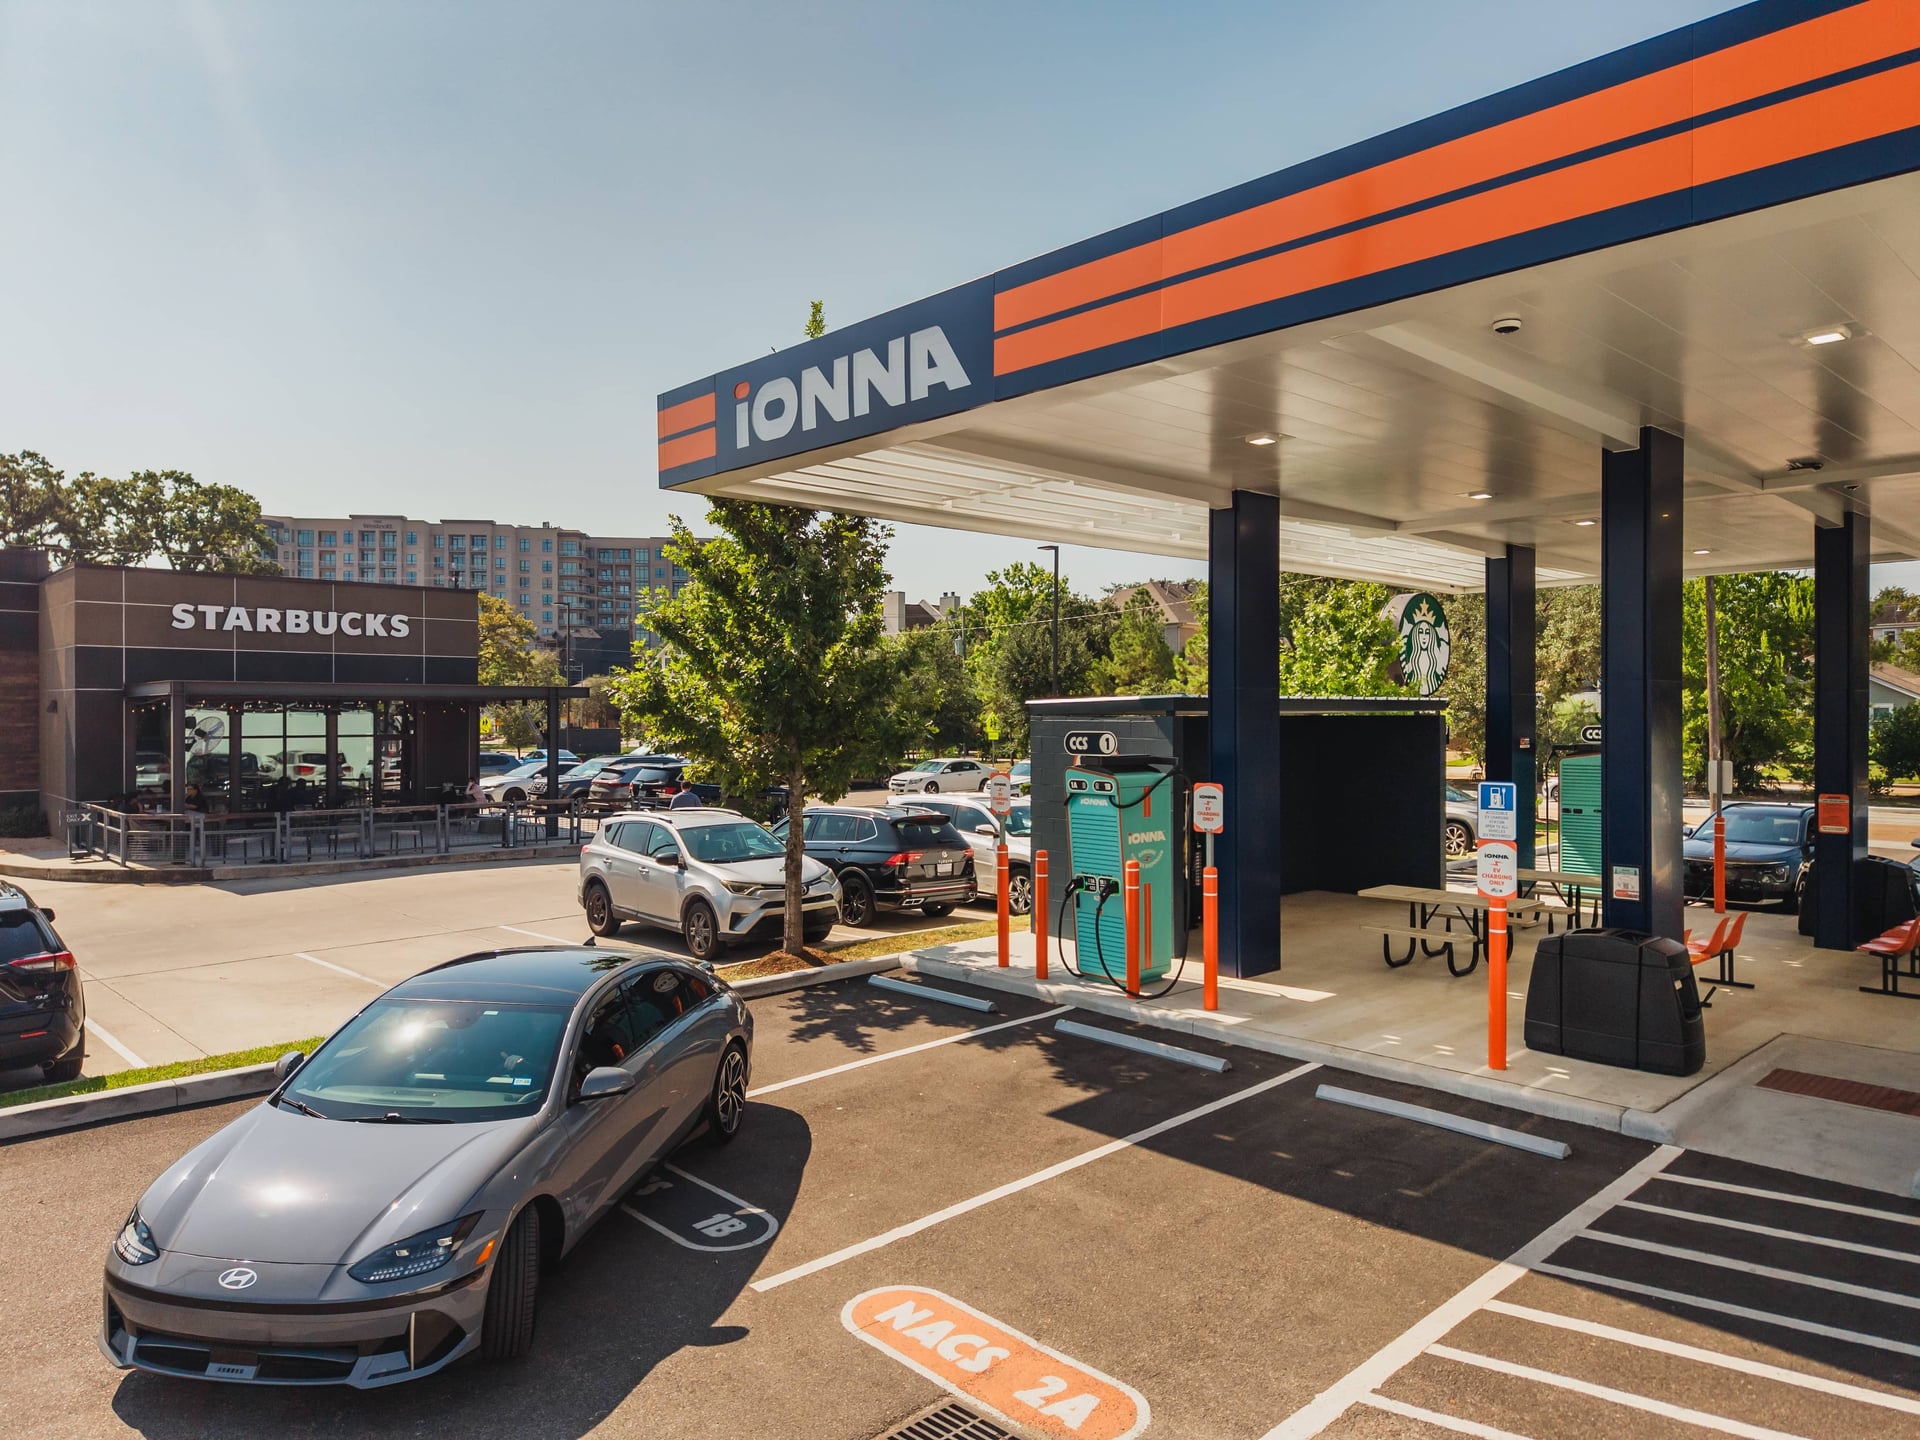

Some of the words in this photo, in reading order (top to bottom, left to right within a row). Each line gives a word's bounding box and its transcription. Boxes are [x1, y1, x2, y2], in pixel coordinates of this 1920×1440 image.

[734, 325, 972, 449] iONNA
[171, 603, 410, 638] STARBUCKS
[1069, 736, 1088, 750] CCS
[1105, 737, 1110, 750] 1
[1481, 873, 1513, 881] CHARGING
[692, 1213, 748, 1238] 1B
[873, 1300, 1011, 1373] NACS
[1012, 1375, 1101, 1431] 2A
